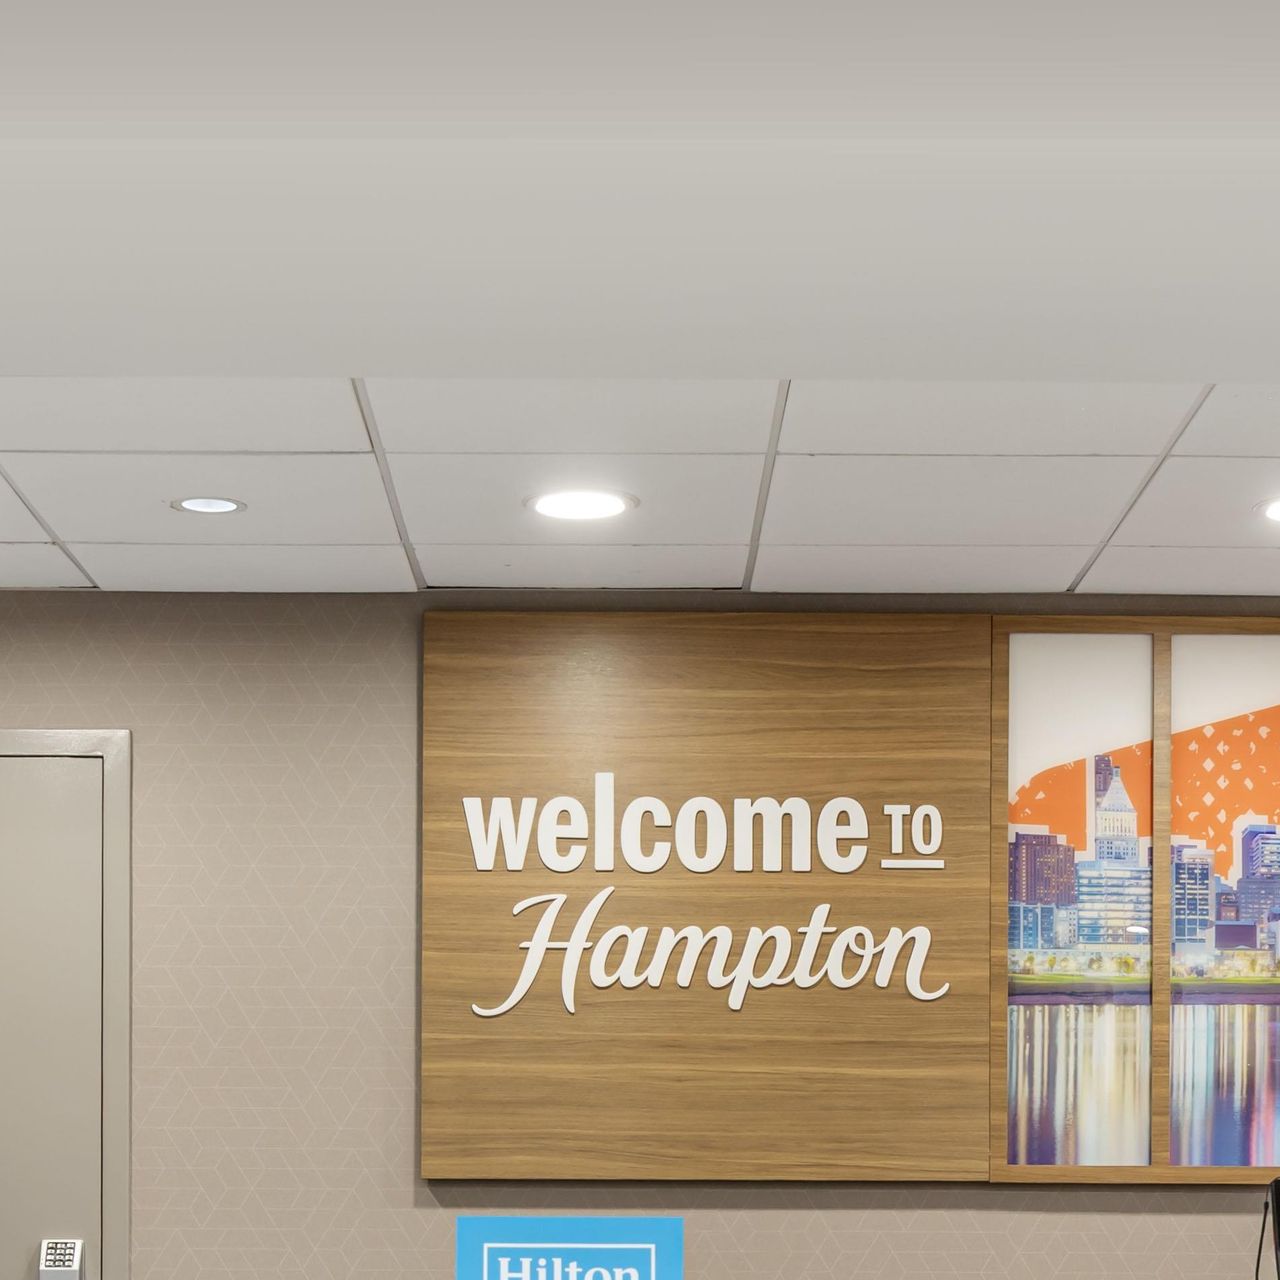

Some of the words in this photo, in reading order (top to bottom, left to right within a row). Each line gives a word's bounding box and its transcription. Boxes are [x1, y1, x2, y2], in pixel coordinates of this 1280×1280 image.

[462, 771, 869, 873] welcome
[882, 804, 943, 856] TO
[471, 886, 950, 1017] Hampton
